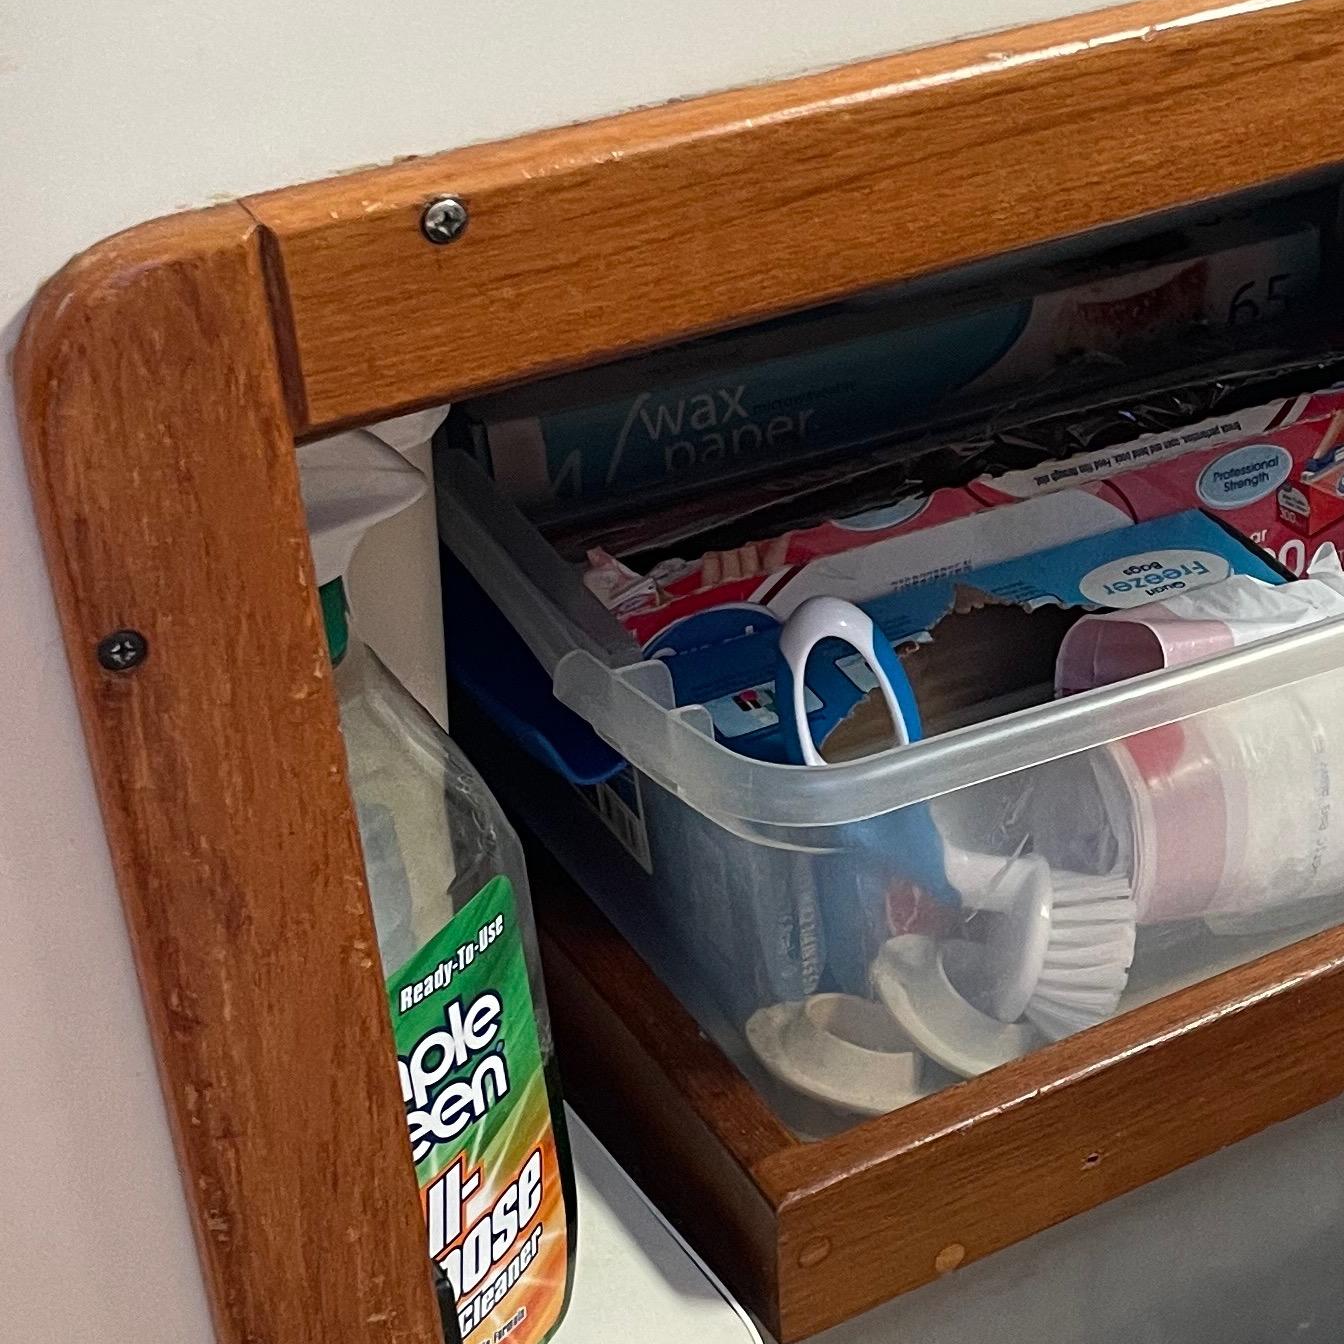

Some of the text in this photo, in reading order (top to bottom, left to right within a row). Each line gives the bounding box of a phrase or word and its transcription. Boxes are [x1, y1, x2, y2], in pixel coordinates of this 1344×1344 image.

[638, 385, 748, 441] wax
[664, 410, 811, 474] paper
[1213, 455, 1279, 482] Professional
[1224, 470, 1270, 494] Strength
[1102, 560, 1211, 596] Freezer
[1122, 561, 1163, 576] Bags
[400, 914, 504, 1014] Ready-To-Use
[406, 1054, 508, 1162] een
[428, 1160, 481, 1261] ll-
[458, 1223, 542, 1340] Cleaner
